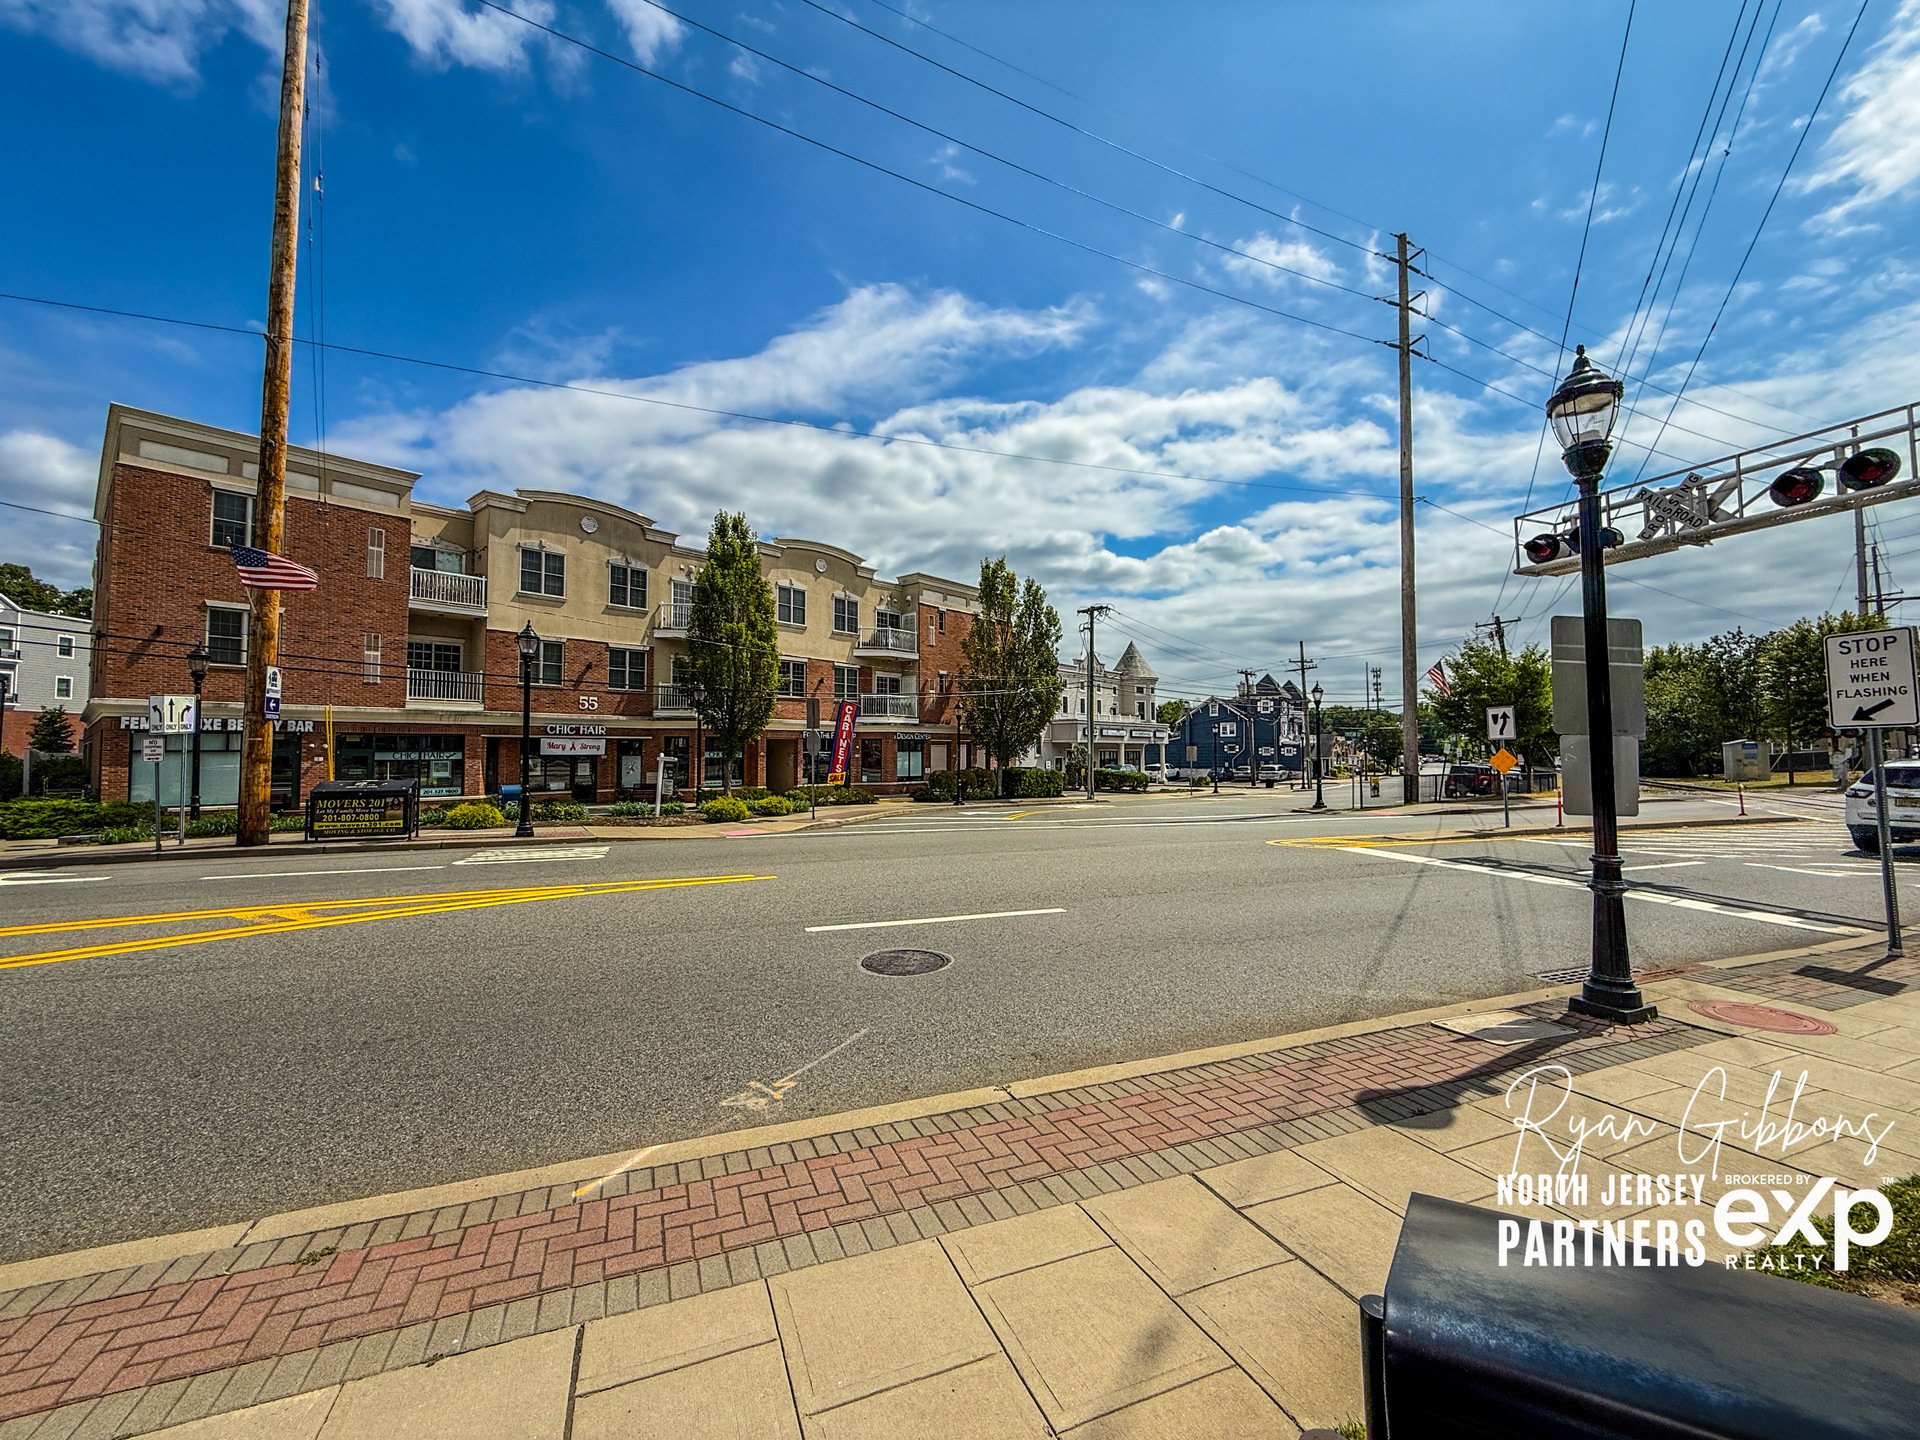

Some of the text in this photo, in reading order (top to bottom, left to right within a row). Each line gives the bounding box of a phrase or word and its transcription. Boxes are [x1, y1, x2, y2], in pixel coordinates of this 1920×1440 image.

[1637, 488, 1704, 529] RAILROAD
[1640, 473, 1700, 541] CROSSING
[1838, 635, 1898, 655] STOP
[1850, 656, 1888, 669] HERE
[1849, 671, 1890, 684] WHEN
[1836, 685, 1908, 699] FLASHING
[579, 695, 599, 710] 55
[287, 720, 314, 732] BAR
[546, 724, 607, 735] CHIC HAIR
[835, 705, 853, 773] CABINETS
[546, 741, 601, 751] Mary Strong
[392, 752, 445, 760] CHIC HAIR
[829, 773, 845, 783] SALE
[316, 798, 385, 809] MOVERS 201
[322, 813, 380, 822] 201-807-0800
[317, 821, 401, 829] www.movers201.com
